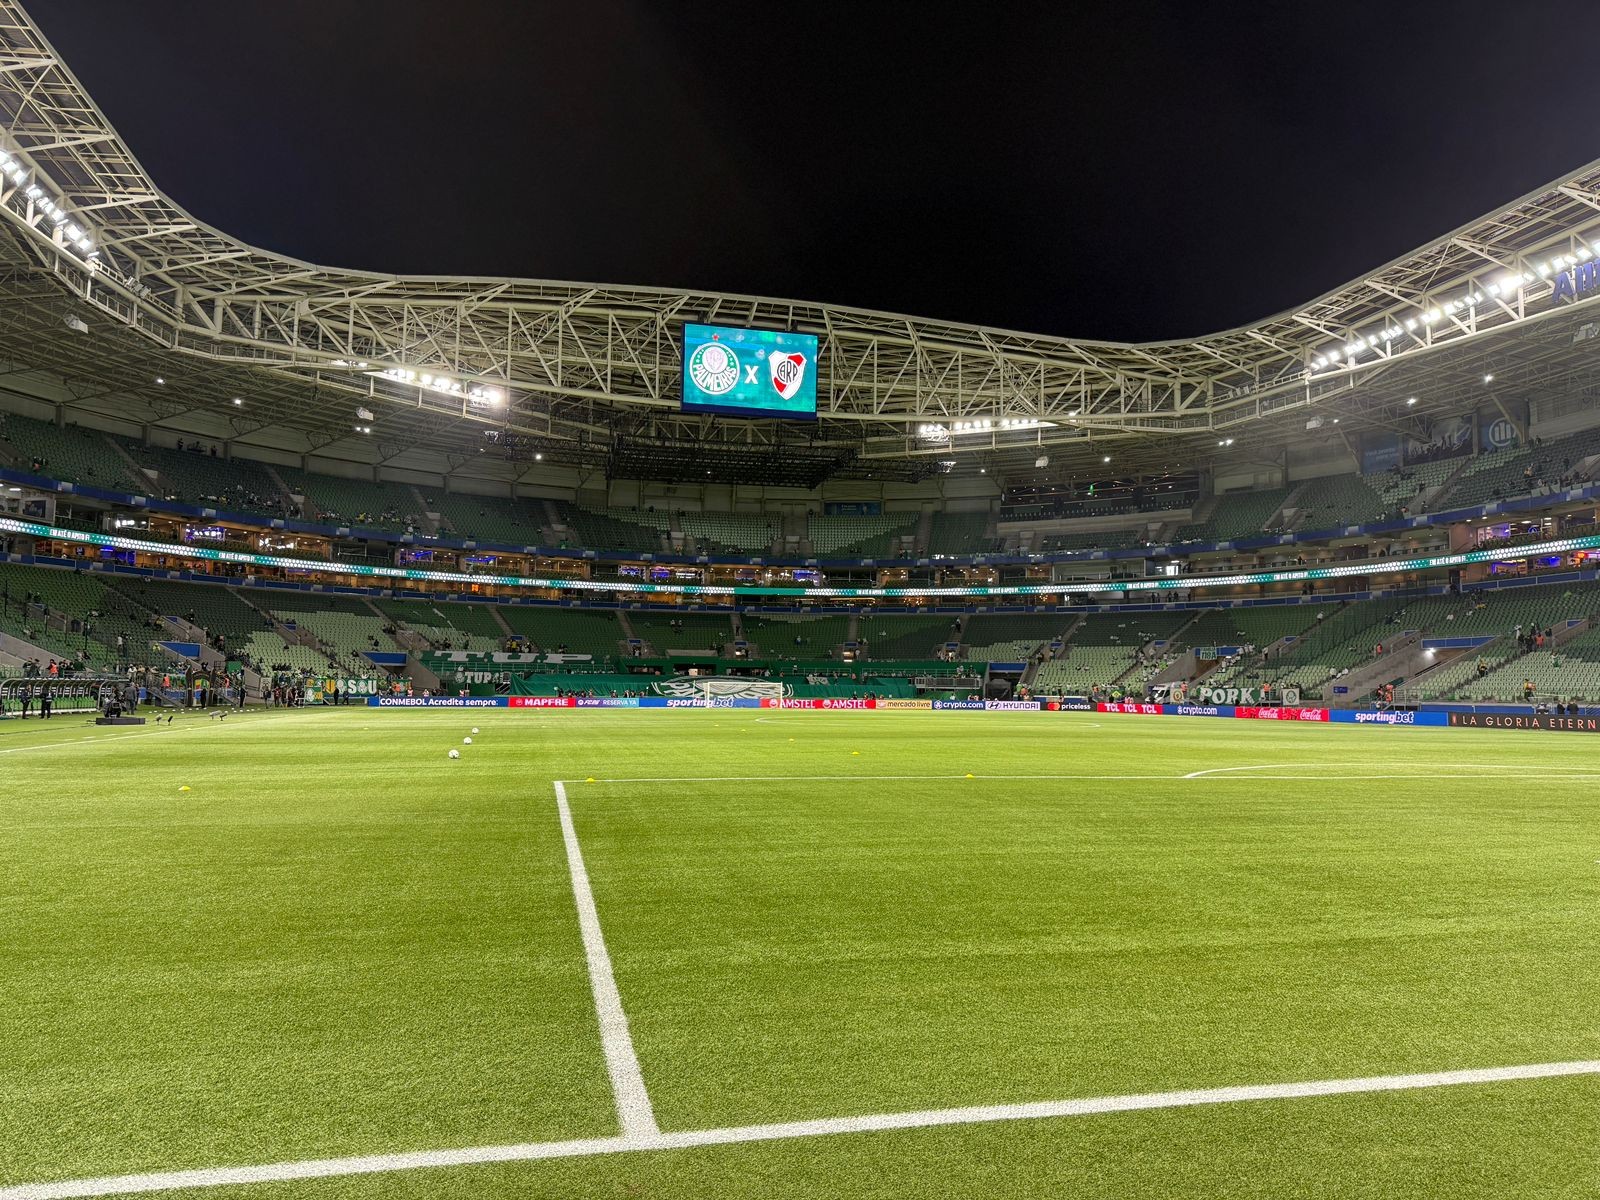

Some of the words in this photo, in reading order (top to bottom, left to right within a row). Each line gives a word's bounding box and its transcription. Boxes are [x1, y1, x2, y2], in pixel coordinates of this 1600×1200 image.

[380, 698, 427, 706] CONMEBOL
[428, 698, 464, 706] Acredite
[524, 698, 569, 706] MAPFRE
[667, 697, 734, 708] sportingbet
[780, 699, 815, 708] AMSTEL
[832, 700, 867, 709] AMSTEL
[943, 701, 984, 710] crypto.com
[1002, 702, 1039, 710] HYUNDAI
[1061, 702, 1091, 711] priceless
[1104, 704, 1119, 712] TCL
[1123, 704, 1138, 712] TCL
[1140, 705, 1157, 713] TCL
[1182, 706, 1218, 716] crypto.com
[1355, 711, 1415, 724] sportingbet
[1462, 715, 1477, 725] LA
[1485, 716, 1540, 728] GLORIA
